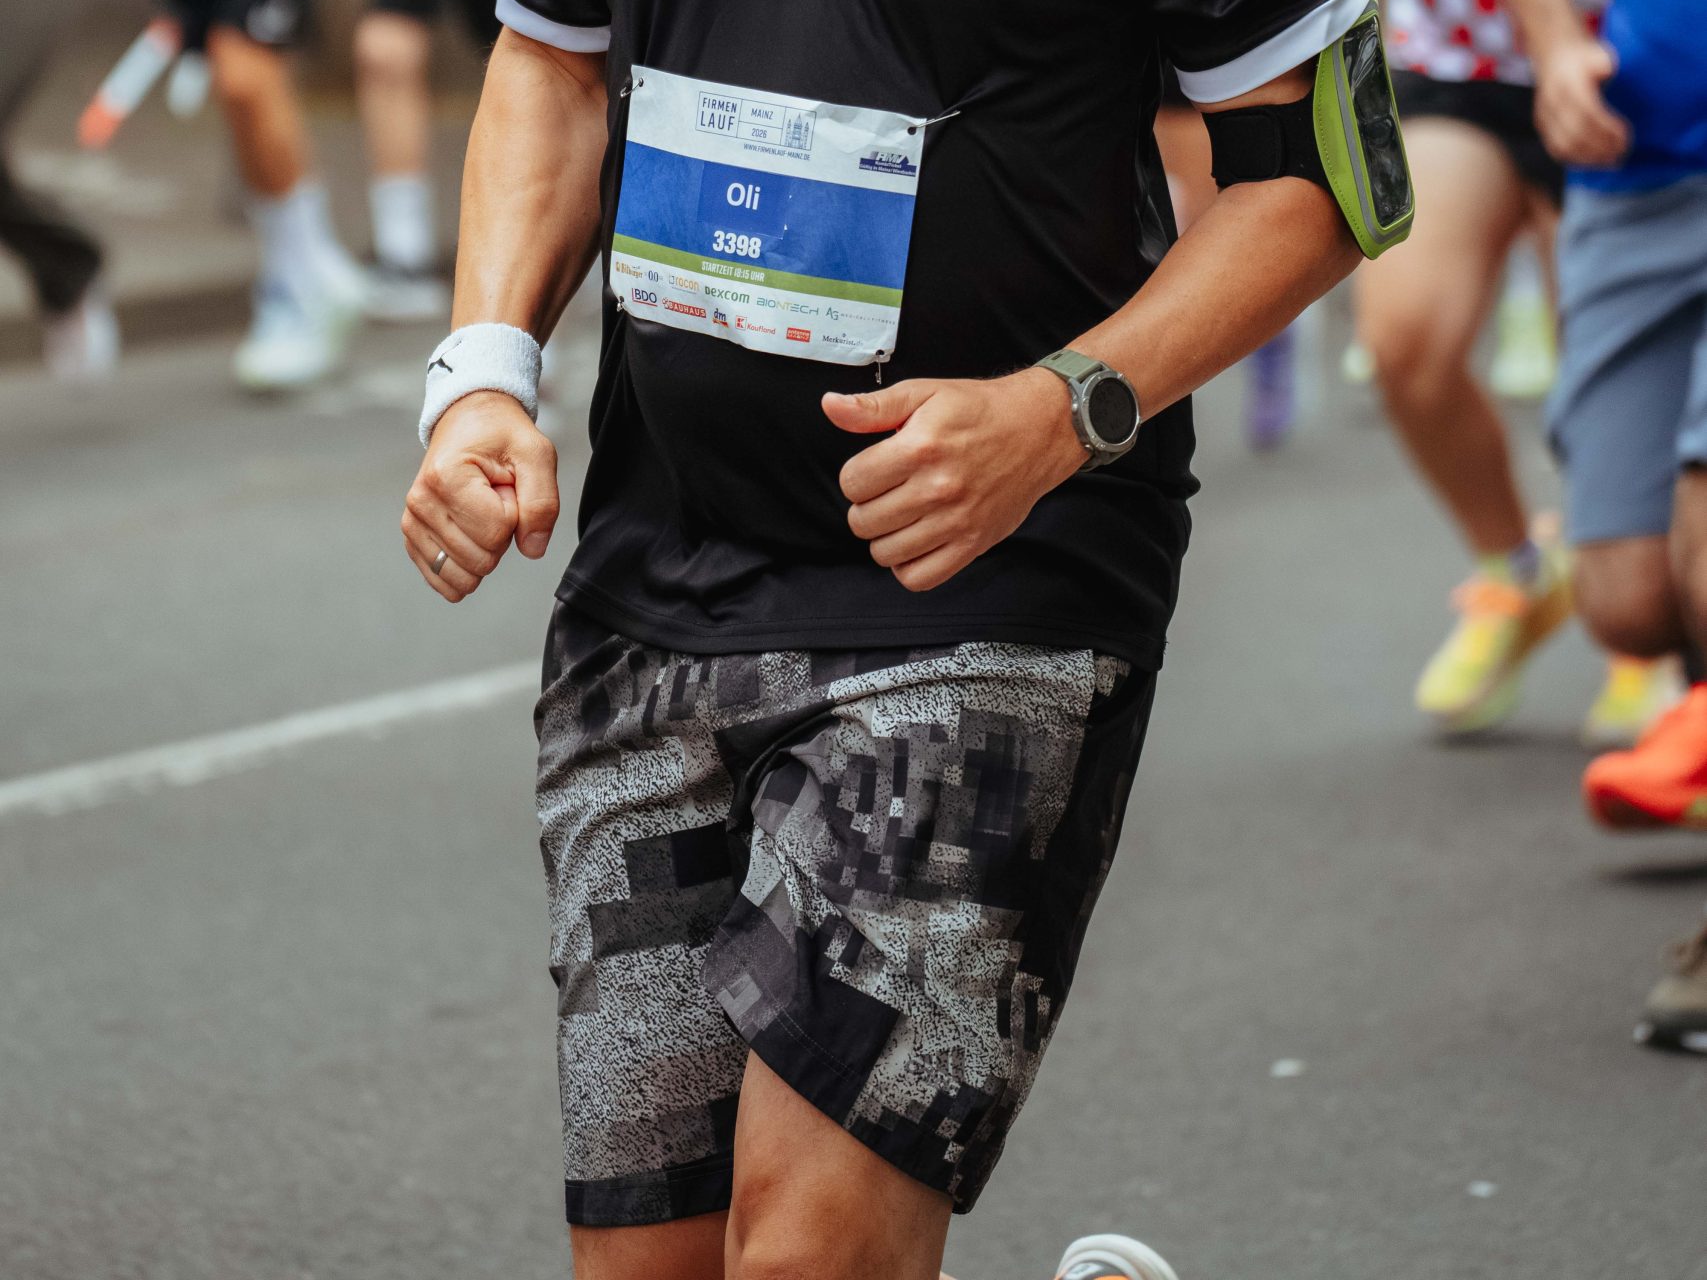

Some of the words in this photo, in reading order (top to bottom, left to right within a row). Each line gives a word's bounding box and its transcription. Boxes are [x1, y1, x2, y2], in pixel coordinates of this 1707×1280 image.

[702, 97, 738, 114] FIRMEN
[750, 107, 774, 120] MAINZ
[700, 110, 736, 132] LAUF
[751, 127, 768, 139] 2026
[726, 182, 761, 210] Oli
[712, 230, 762, 259] 3398
[701, 261, 733, 276] STARTZEIT
[750, 272, 765, 282] UHR
[634, 288, 658, 304] BDO
[667, 300, 706, 317] BAUHAUS
[713, 307, 727, 321] dm
